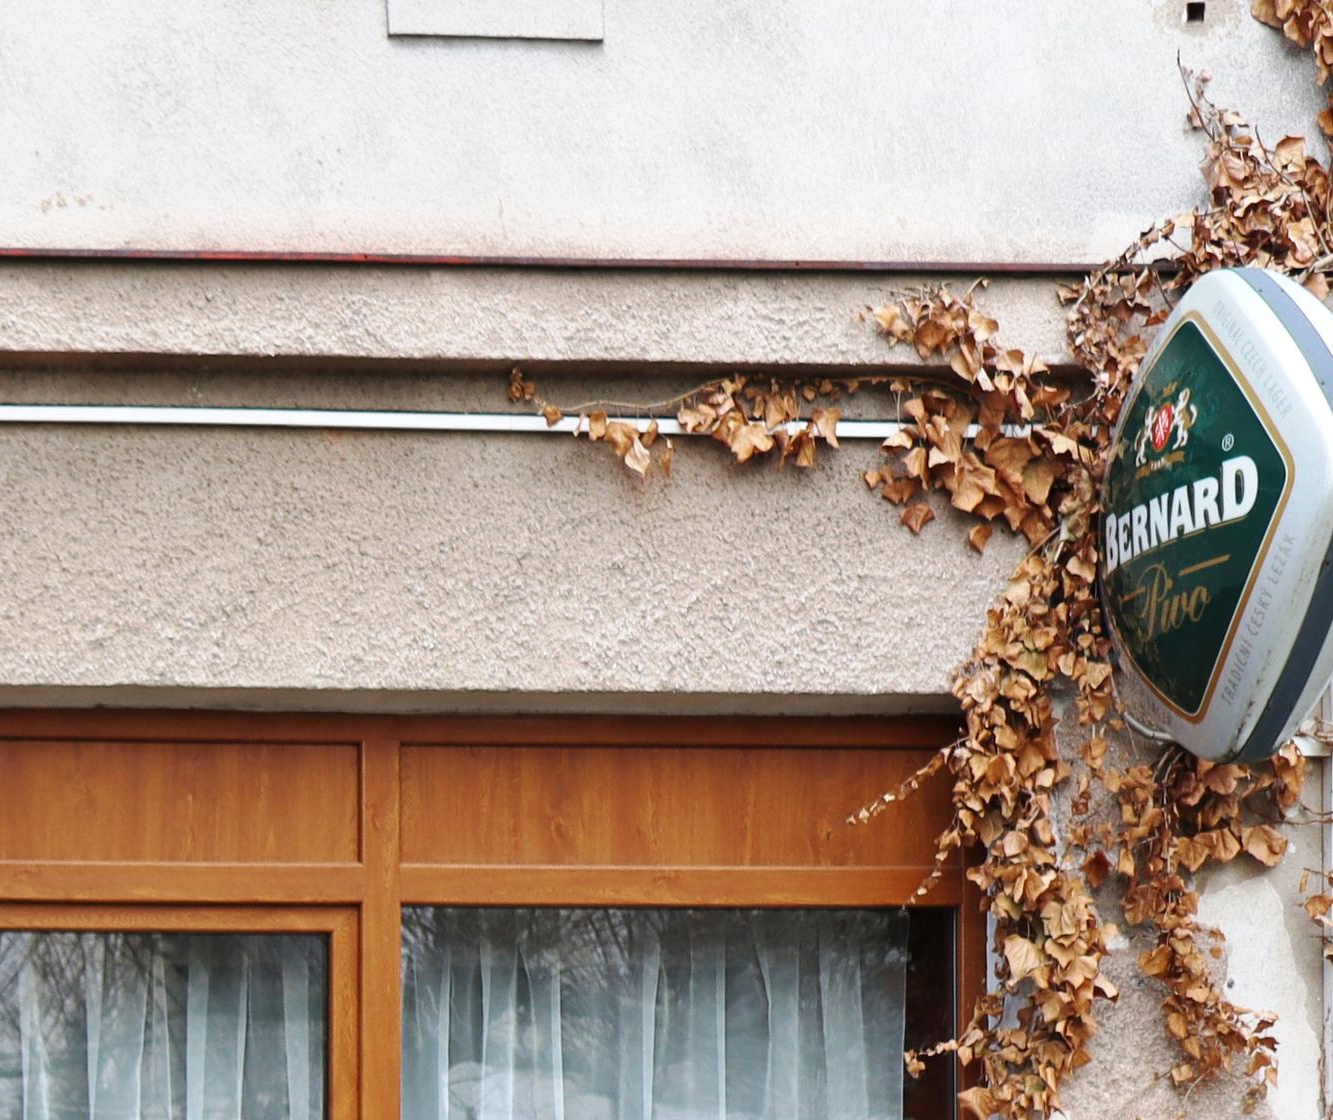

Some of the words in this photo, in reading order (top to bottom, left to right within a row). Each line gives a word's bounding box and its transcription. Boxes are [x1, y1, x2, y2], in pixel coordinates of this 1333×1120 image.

[1240, 341, 1269, 379] CZECH
[1263, 375, 1294, 419] LAGER
[1106, 455, 1258, 575] BERNARD
[1137, 560, 1211, 643] Pivo
